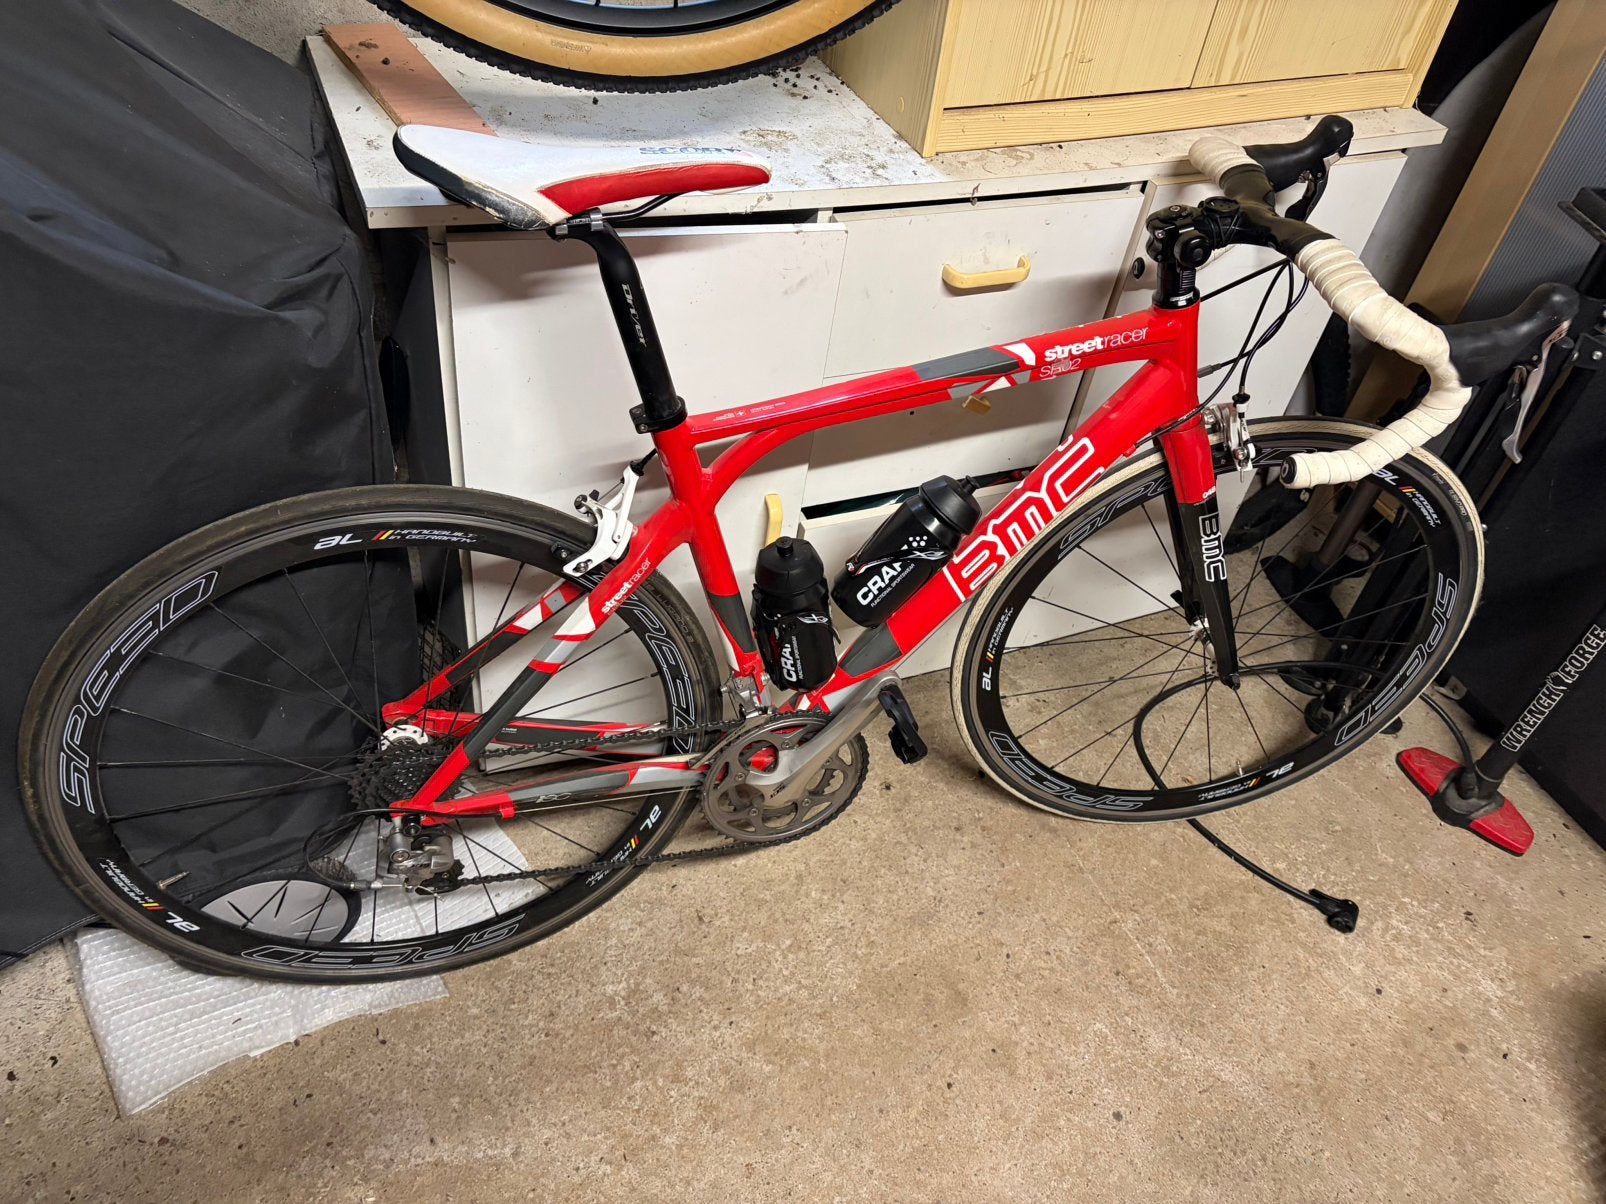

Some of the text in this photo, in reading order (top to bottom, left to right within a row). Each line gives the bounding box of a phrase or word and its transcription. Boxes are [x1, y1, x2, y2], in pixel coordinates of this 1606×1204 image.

[1044, 327, 1149, 362] streetracer
[405, 534, 477, 543] GERMANY
[942, 436, 1106, 603] BMC
[1198, 512, 1228, 582] BMC
[601, 557, 652, 614] streetracer
[59, 570, 219, 815] SPEED
[1333, 571, 1458, 747] SPEED
[1499, 683, 1565, 753] WRENCH
[988, 731, 1155, 812] SPEED
[240, 913, 527, 970] SPEED
